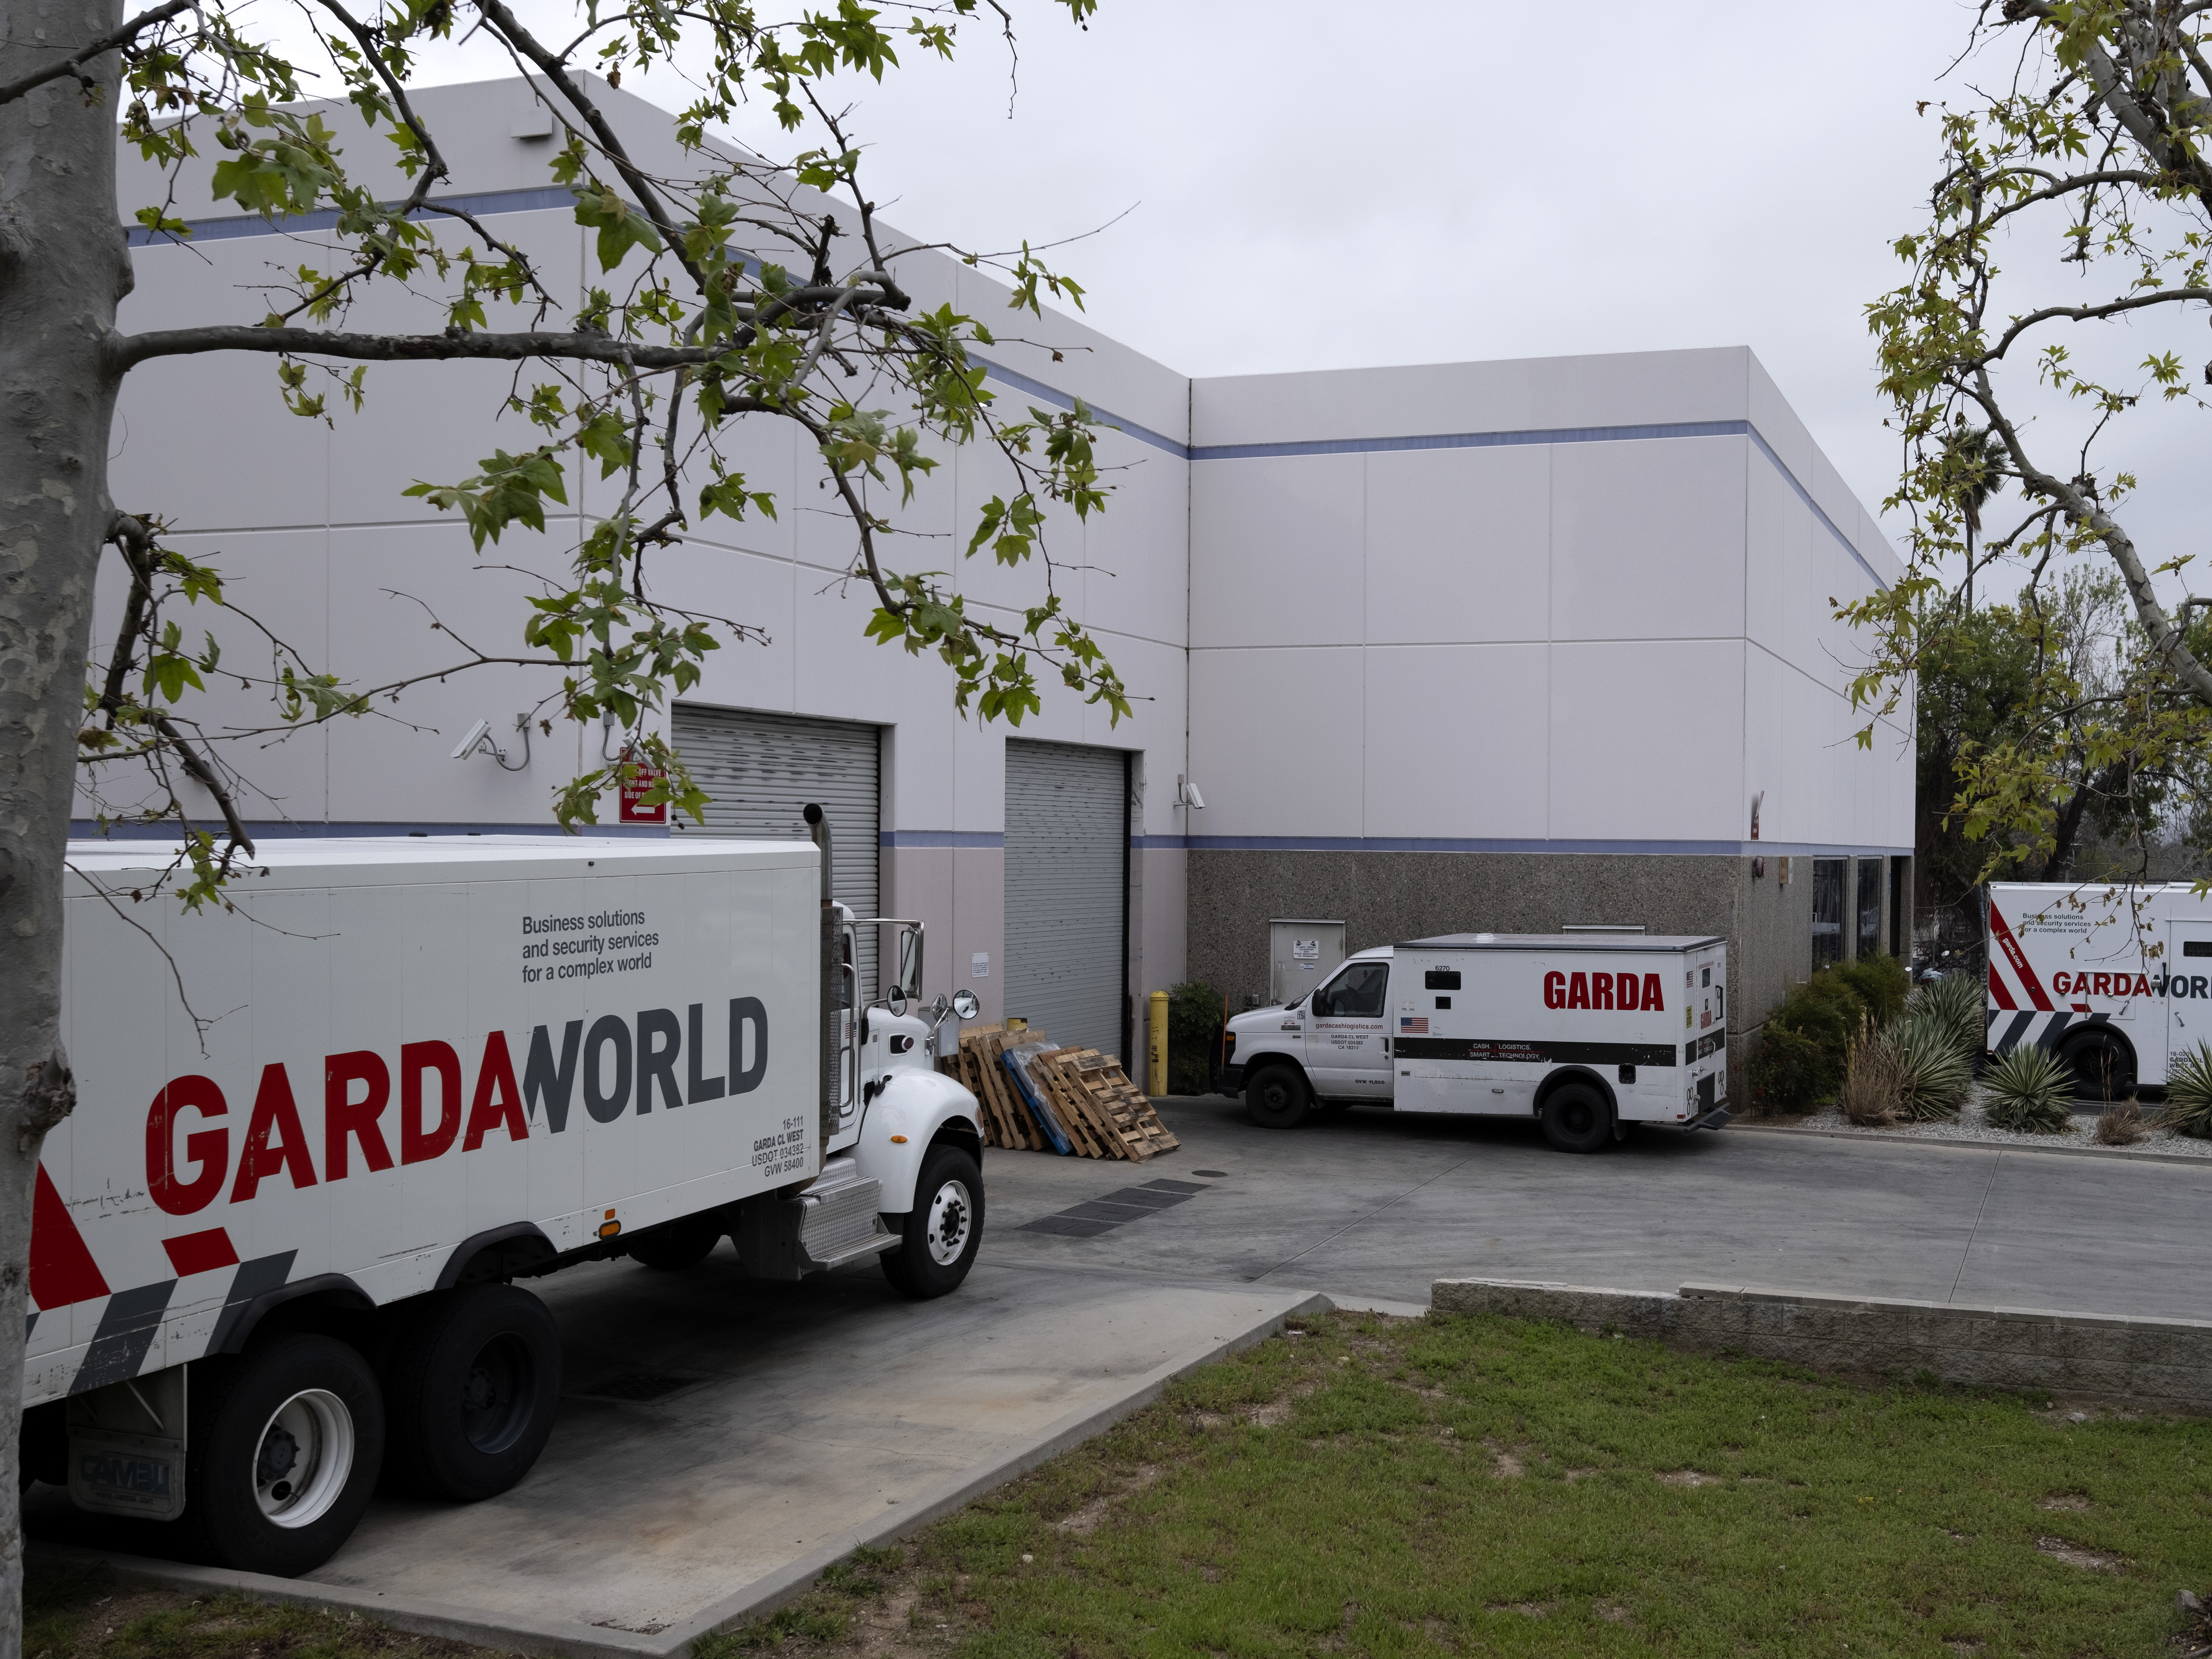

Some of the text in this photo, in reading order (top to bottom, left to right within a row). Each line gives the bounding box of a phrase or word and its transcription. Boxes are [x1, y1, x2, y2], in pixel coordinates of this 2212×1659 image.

[523, 909, 645, 935] Business solutions
[522, 930, 659, 959] and security services
[2002, 938, 2023, 968] garda.com
[522, 952, 652, 983] for a complex world
[1544, 971, 1664, 1012] GARDA
[2053, 971, 2212, 999] GARDAWOR
[1700, 1010, 1712, 1030] GARDA
[146, 996, 768, 1216] GARDAWORLD
[783, 1115, 803, 1131] 16-111
[754, 1129, 803, 1152] GARDA CL WEST
[752, 1143, 804, 1167] USDOT 034382
[765, 1157, 803, 1177] GVW 58400
